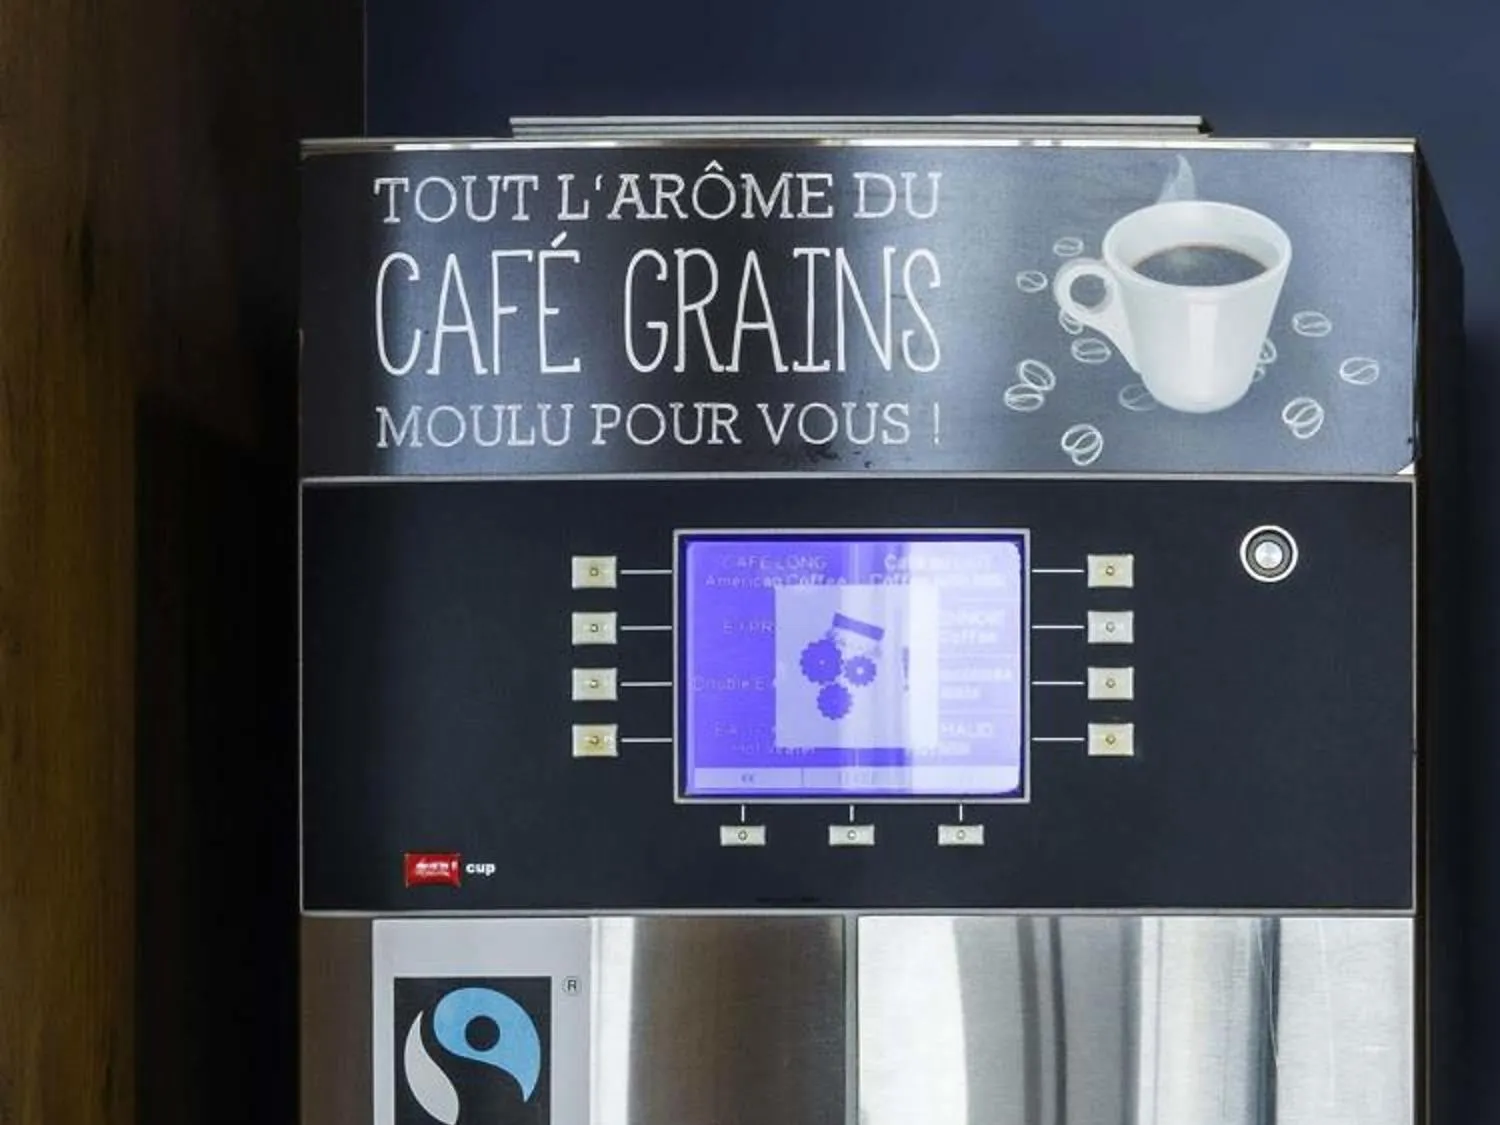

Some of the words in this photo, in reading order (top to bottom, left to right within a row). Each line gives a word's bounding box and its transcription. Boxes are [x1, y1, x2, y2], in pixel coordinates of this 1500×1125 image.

[374, 174, 538, 223] TOUT
[853, 172, 942, 220] DU
[375, 231, 581, 375] CAFÉ
[624, 246, 941, 374] GRAINS
[375, 404, 574, 447] MOULU
[591, 403, 741, 446] POUR
[758, 403, 910, 445] VOUS
[465, 863, 497, 876] cup
